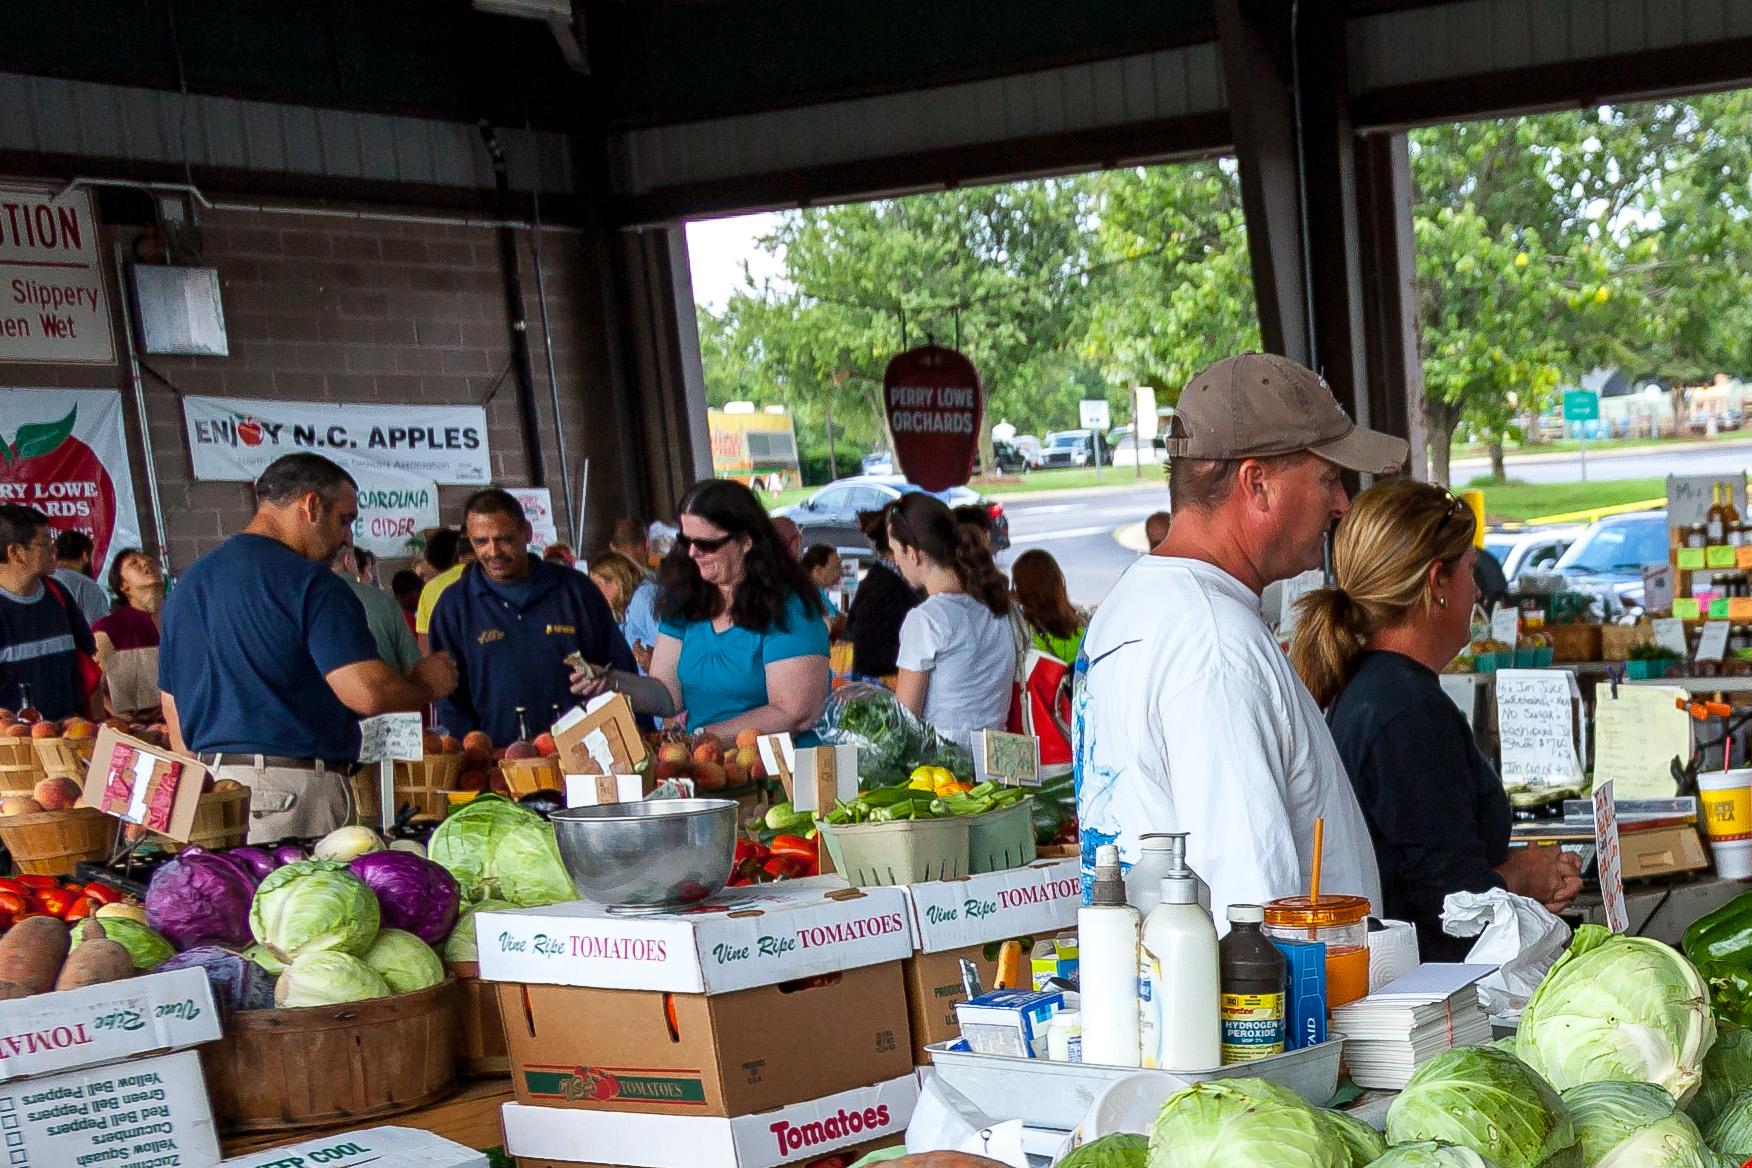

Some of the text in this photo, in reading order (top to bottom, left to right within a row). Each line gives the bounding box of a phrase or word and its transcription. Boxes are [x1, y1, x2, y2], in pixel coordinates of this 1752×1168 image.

[0, 203, 82, 250] TION
[11, 277, 98, 312] Slippery
[0, 313, 77, 339] en Wet
[890, 387, 974, 407] PERRY LOWE
[892, 411, 973, 434] ORCHARDS
[293, 426, 358, 450] N.C.
[368, 426, 481, 449] APPLES
[33, 481, 99, 499] LOWE
[370, 517, 415, 538] CIDER
[926, 876, 1080, 925] Vine Ripe TOMATOE
[499, 931, 667, 962] Vine Ripe TOMATOES
[712, 912, 904, 966] Vine Ripe TOMATOES
[0, 999, 200, 1059] Vine Ripe TOMA
[1225, 1021, 1278, 1030] HYDROGEN
[1227, 1029, 1276, 1038] PEROXIDE
[21, 1072, 164, 1107] Yellow Bell Peppers
[619, 1080, 684, 1098] TOMATOES
[27, 1088, 166, 1123] Green Bell Peppers
[46, 1104, 171, 1137] Red Bell Peppers
[91, 1121, 175, 1145] Cucumbers
[769, 1103, 891, 1157] Tomatoes
[76, 1138, 180, 1168] Yellow Squash
[308, 1140, 373, 1165] COOL
